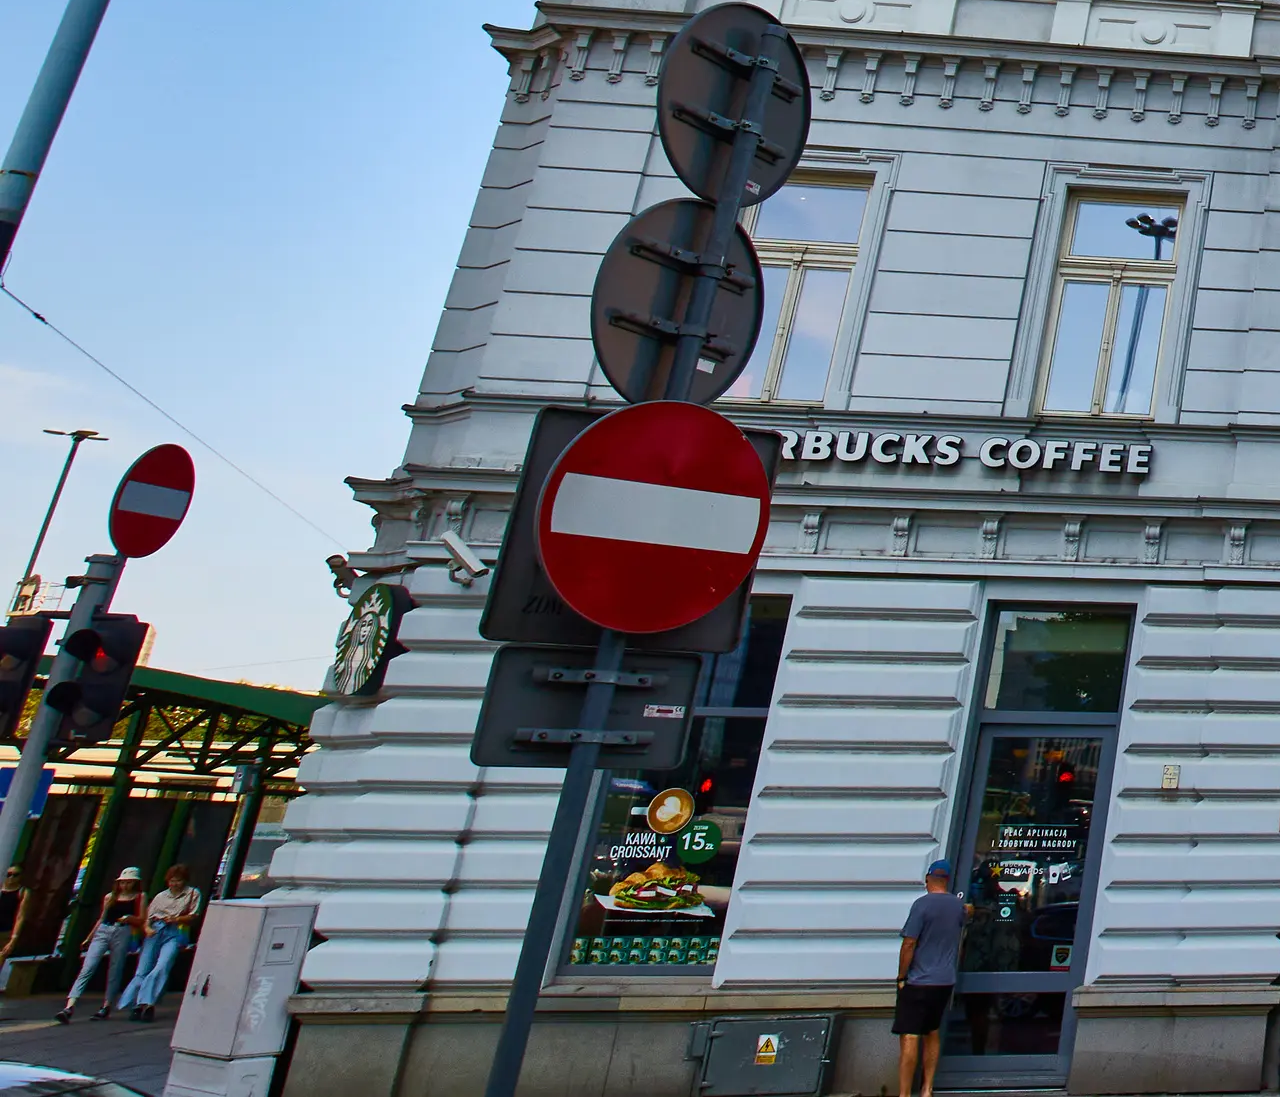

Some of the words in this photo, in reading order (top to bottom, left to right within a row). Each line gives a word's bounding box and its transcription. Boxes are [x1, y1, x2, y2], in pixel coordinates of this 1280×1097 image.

[780, 429, 963, 465] RBUCKS
[979, 437, 1153, 474] COFFEE
[625, 832, 657, 846] KAWA
[1003, 827, 1024, 837] PŁAĆ
[1026, 829, 1068, 839] APLIKACJĄ
[681, 831, 706, 851] 15
[998, 839, 1038, 848] ZDOBYWAJ
[1041, 839, 1077, 848] NAGRODY
[609, 845, 673, 859] CROISSANT
[1004, 867, 1044, 875] REWARDS
